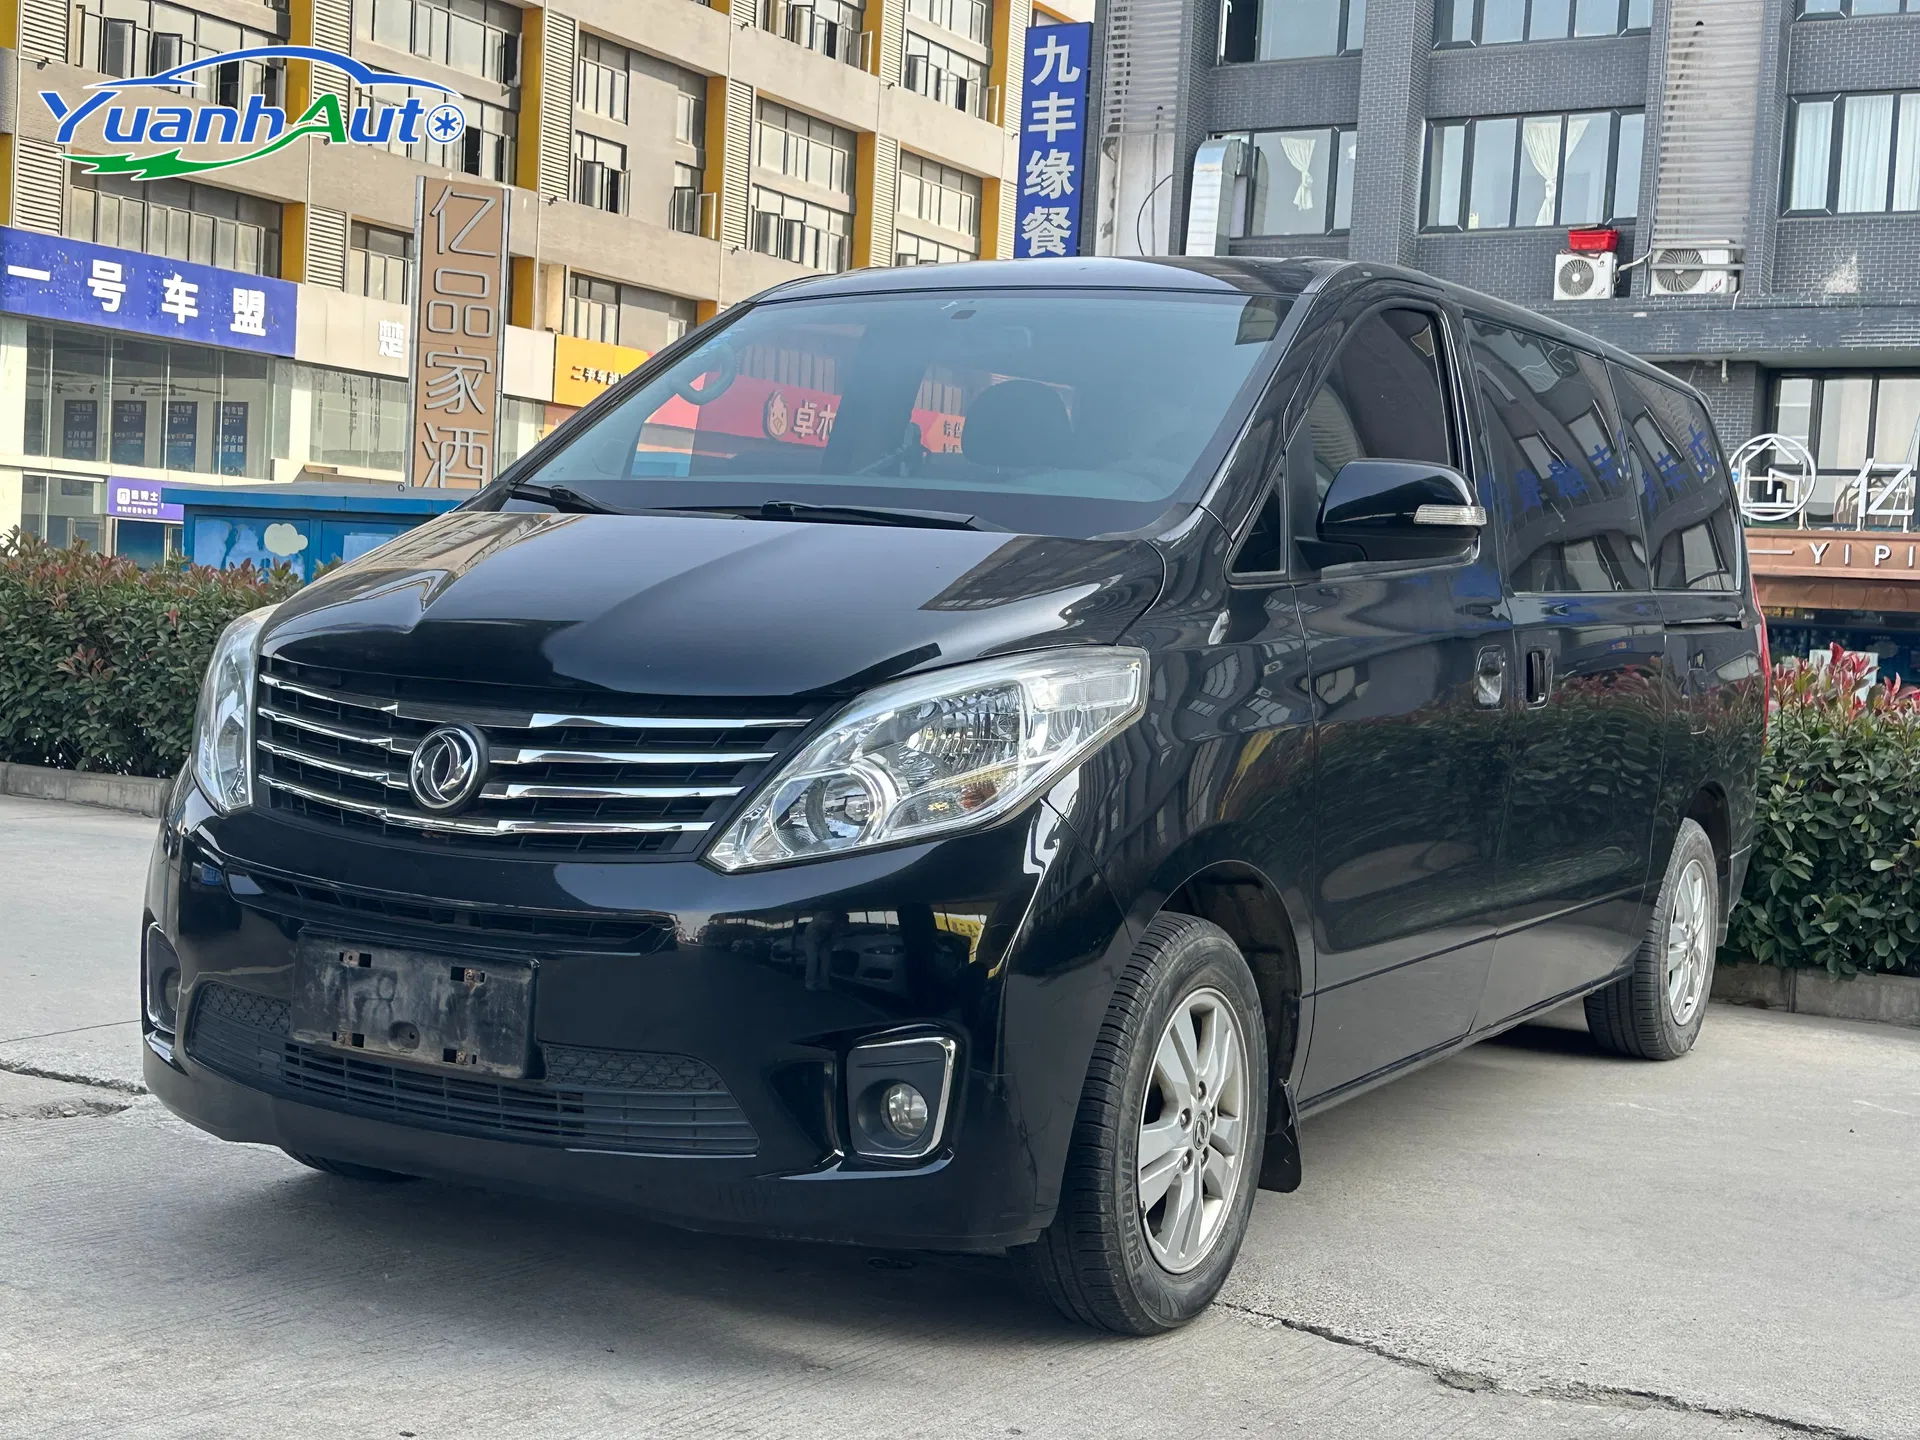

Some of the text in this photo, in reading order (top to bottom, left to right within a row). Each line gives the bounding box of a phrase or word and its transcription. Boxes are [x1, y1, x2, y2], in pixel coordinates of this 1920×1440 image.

[1021, 35, 1081, 257] 九丰缘餐
[7, 259, 267, 337] 一号车盟
[423, 185, 499, 489] 亿品家酒
[1852, 457, 1915, 519] 亿
[1122, 1139, 1144, 1272] EUROVIS
